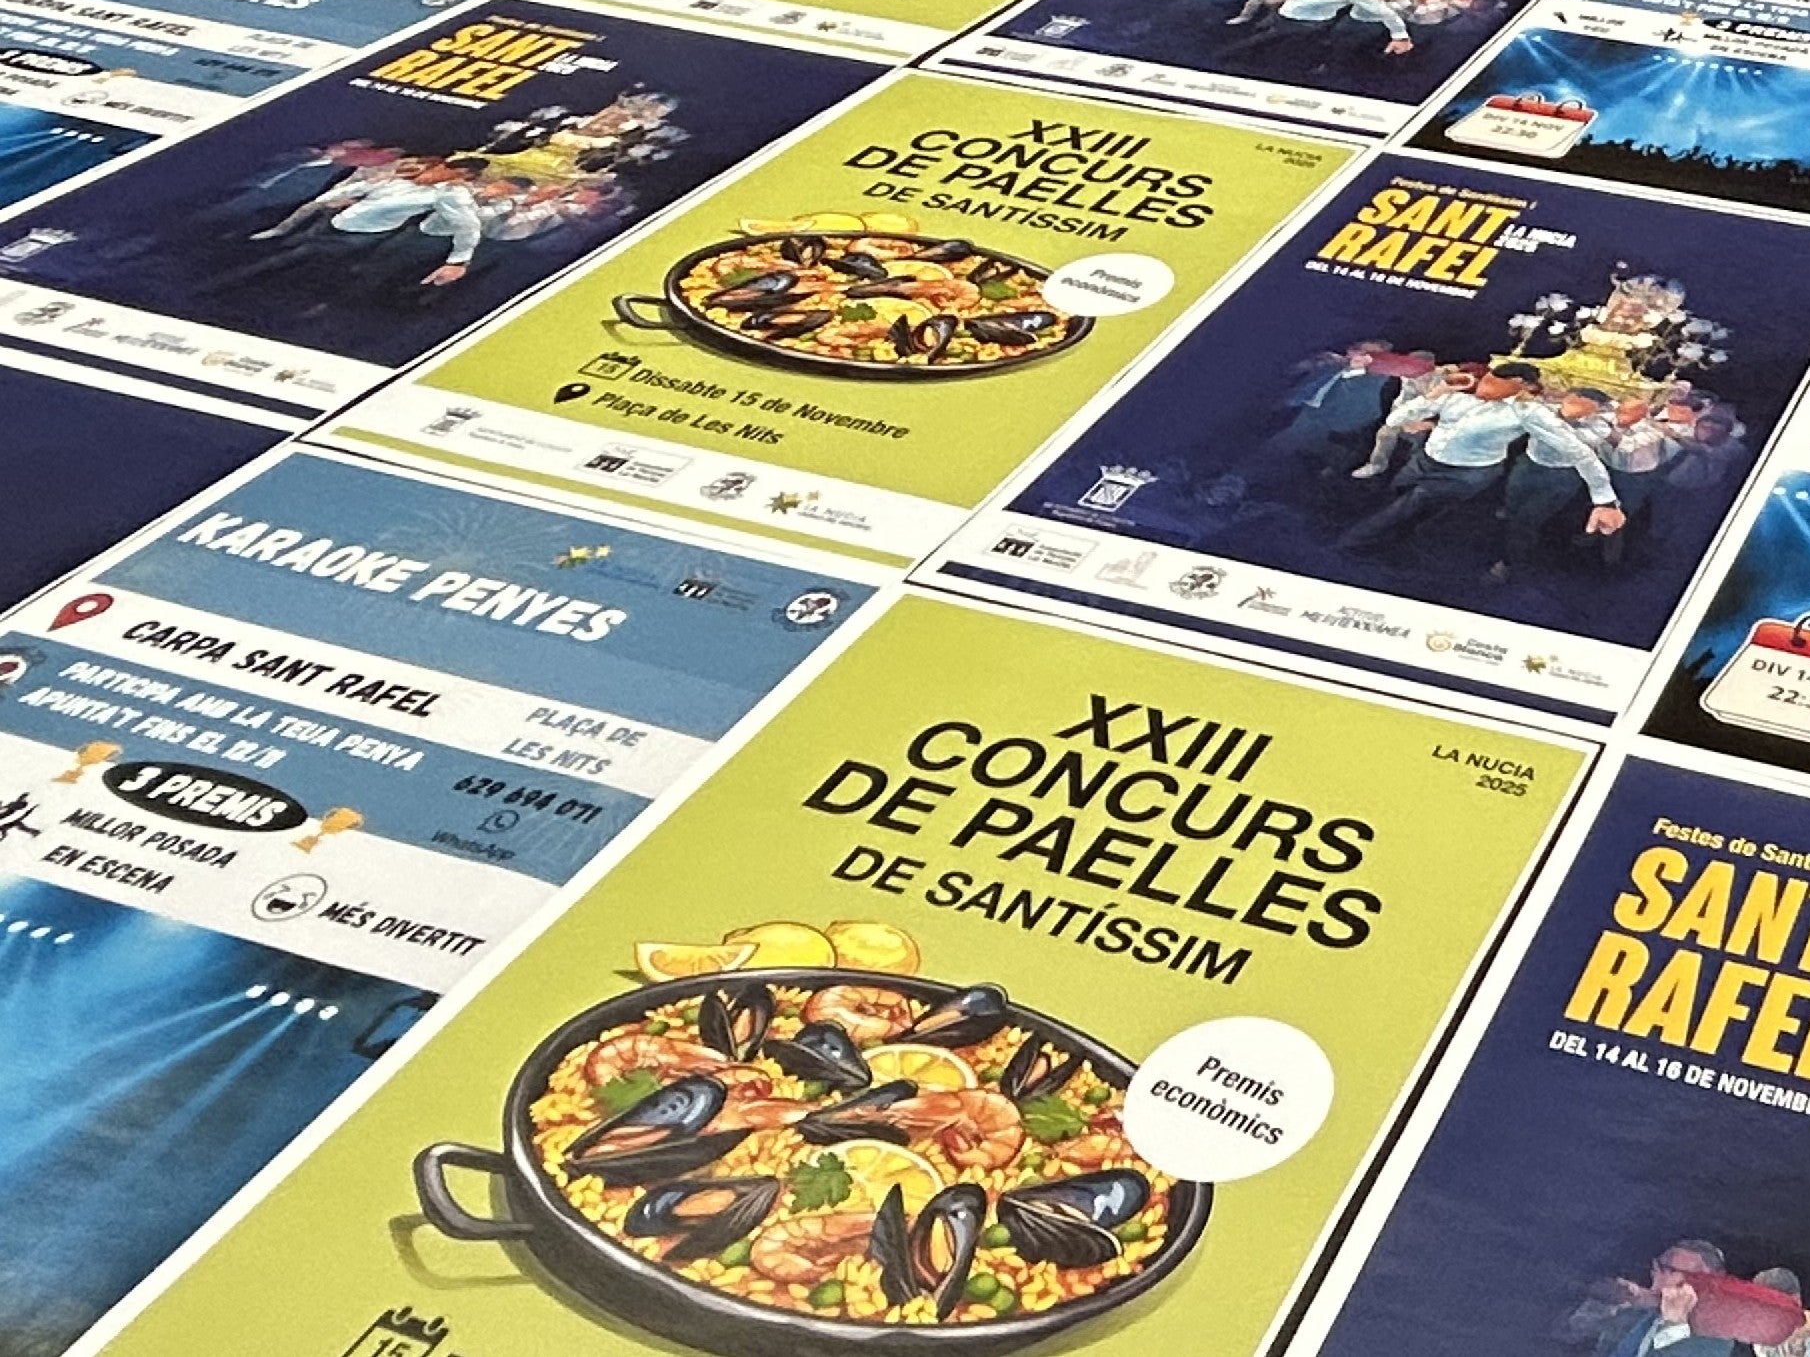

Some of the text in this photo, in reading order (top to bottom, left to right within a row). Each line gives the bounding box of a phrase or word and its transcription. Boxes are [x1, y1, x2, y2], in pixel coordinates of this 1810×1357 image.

[430, 22, 584, 66] SANT
[369, 49, 538, 100] RAFEL
[910, 129, 1214, 198] CONCURS
[1008, 119, 1151, 159] XXIII
[843, 145, 1214, 229] DE PAELLES
[863, 181, 1128, 242] DE SANTÍSSIM
[1357, 188, 1521, 242] SANT
[1317, 223, 1499, 286] RAFEL
[591, 391, 784, 446] Plaça de Les Nits
[630, 367, 910, 440] Dissabte 15 de Novembre
[177, 511, 628, 642] KARAOKE PENYES
[122, 620, 441, 718] CARPA SANT RAFEL
[1750, 658, 1791, 677] DIV
[58, 660, 425, 772] PARTICIPA AMB LA TEUA PENYA
[130, 715, 193, 744] FINS
[188, 728, 227, 753] EL
[525, 706, 648, 747] PLAÇA DE
[1055, 693, 1275, 783] XXIII
[502, 738, 612, 775] LES NITS
[1432, 744, 1536, 782] LA NUCIA
[1474, 773, 1528, 797] 2025
[117, 766, 289, 828] 3 PREMIS
[453, 774, 603, 824] 629 694 071
[905, 720, 1376, 874] CONCURS
[61, 808, 239, 869] MILLOR POSADA
[802, 759, 1382, 949] DE PAELLES
[1653, 817, 1725, 850] Festes
[1728, 835, 1757, 857] de
[40, 845, 175, 894] EN ESCENA
[317, 901, 486, 956] MÉS DIVERTIT
[832, 845, 1253, 985] DE SANTÍSSIM
[1196, 1054, 1285, 1107] Premis
[1549, 1029, 1588, 1058] DEL
[1594, 1042, 1620, 1065] 14
[1622, 1048, 1650, 1073] AL
[1656, 1058, 1682, 1081] 16
[1685, 1064, 1713, 1089] DE
[1150, 1078, 1284, 1146] econòmics
